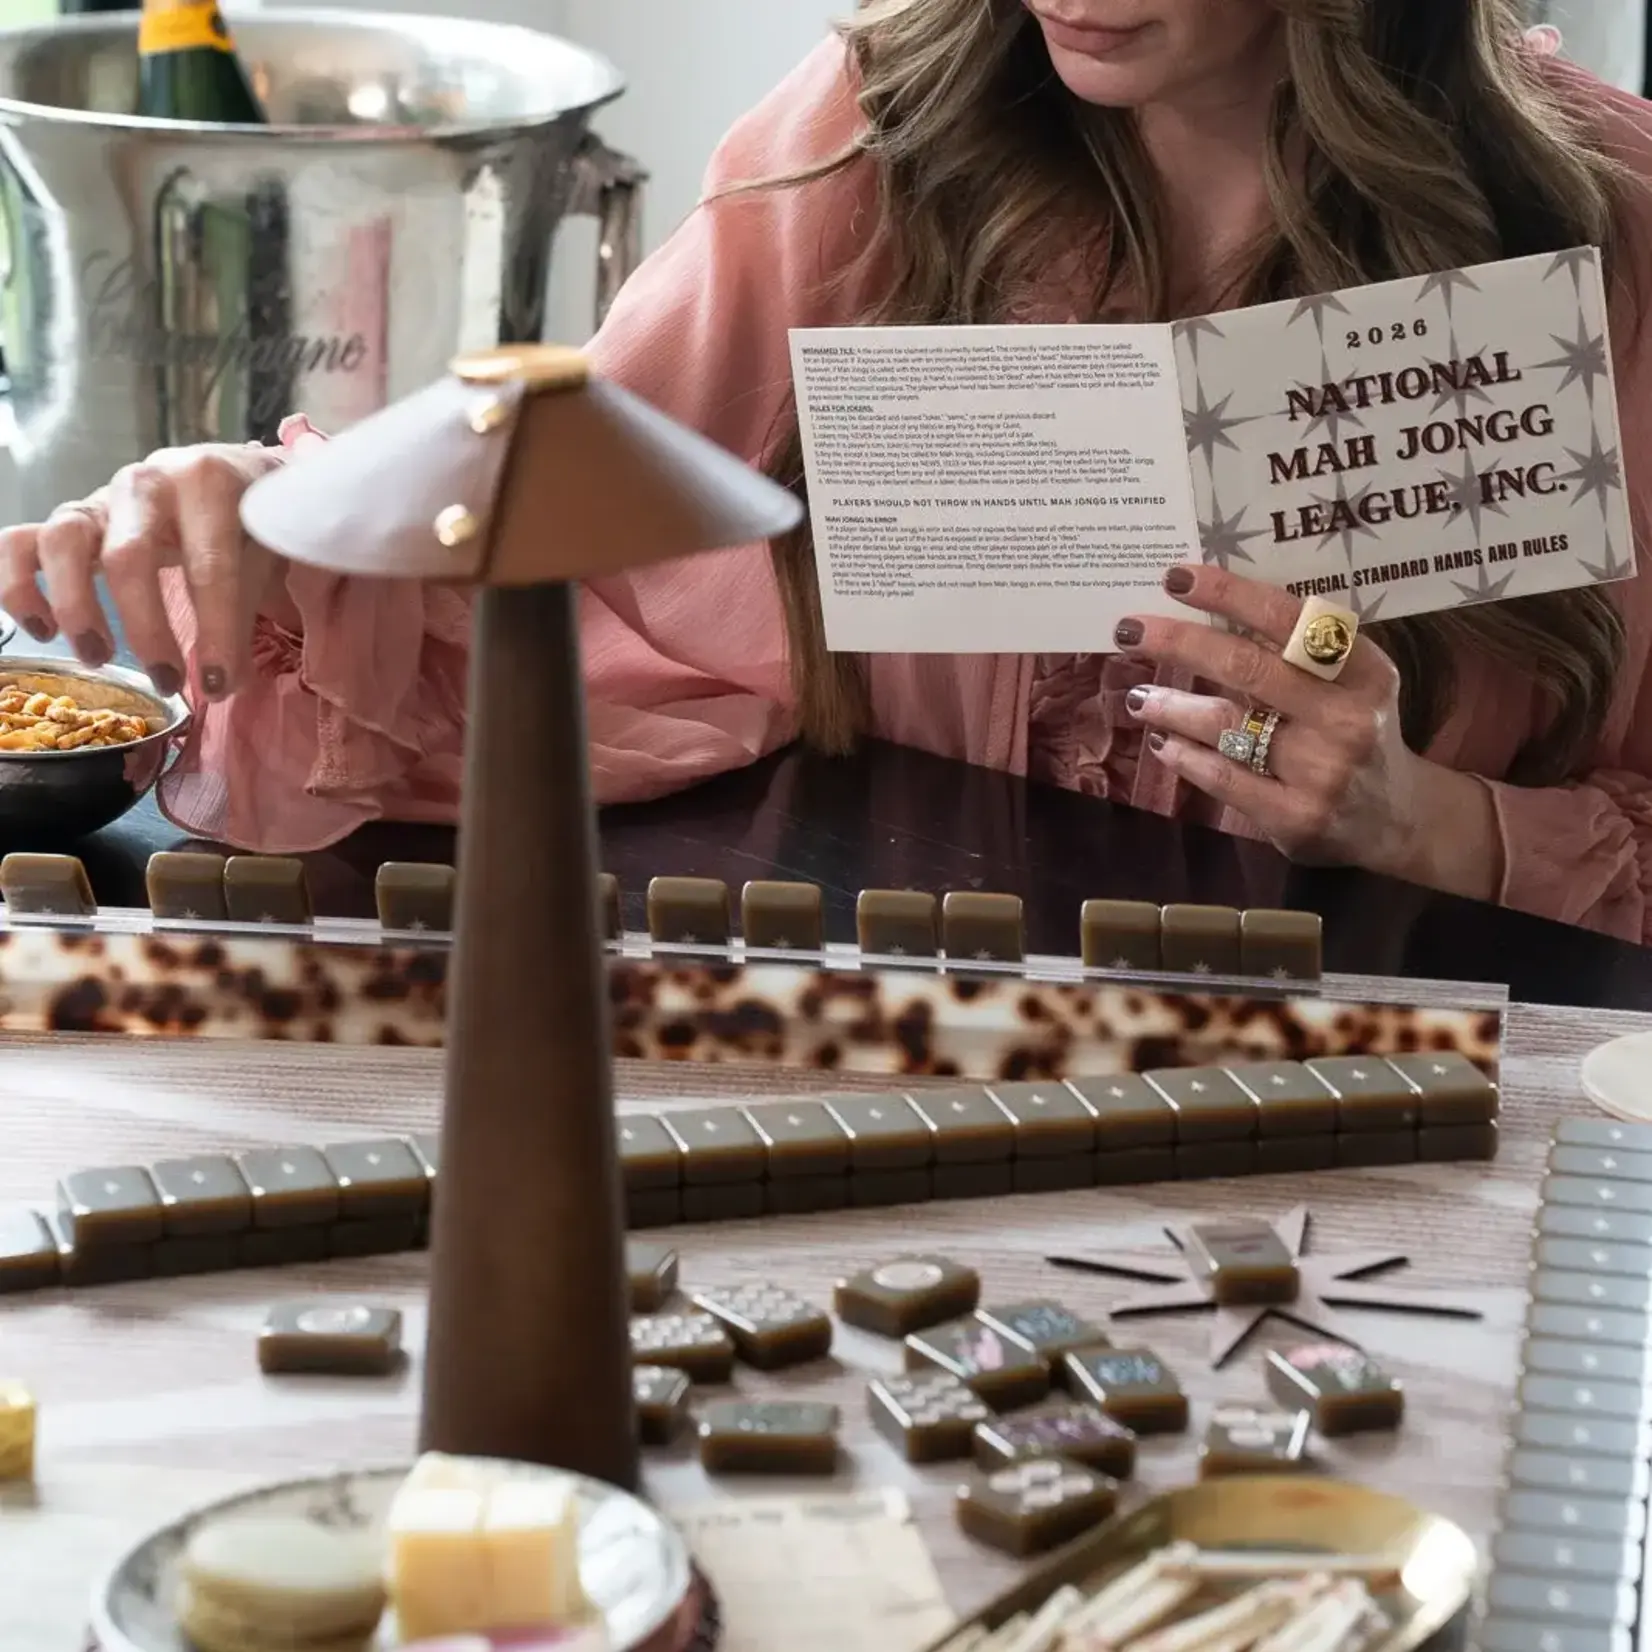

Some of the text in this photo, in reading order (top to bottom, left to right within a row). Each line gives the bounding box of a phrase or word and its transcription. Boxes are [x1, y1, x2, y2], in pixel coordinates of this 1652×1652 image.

[1346, 318, 1427, 349] 2026
[1285, 350, 1522, 421] NATIONAL
[1267, 403, 1555, 484] MAH JONGG
[832, 497, 1166, 507] PLAYERS SHOULD NOT THROW IN HANDS UNTIL MAH JONGG IS VERIFIED
[1477, 462, 1568, 505] INC.
[1286, 533, 1570, 597] OFFICIAL STANDARD HANDS AND RULES
